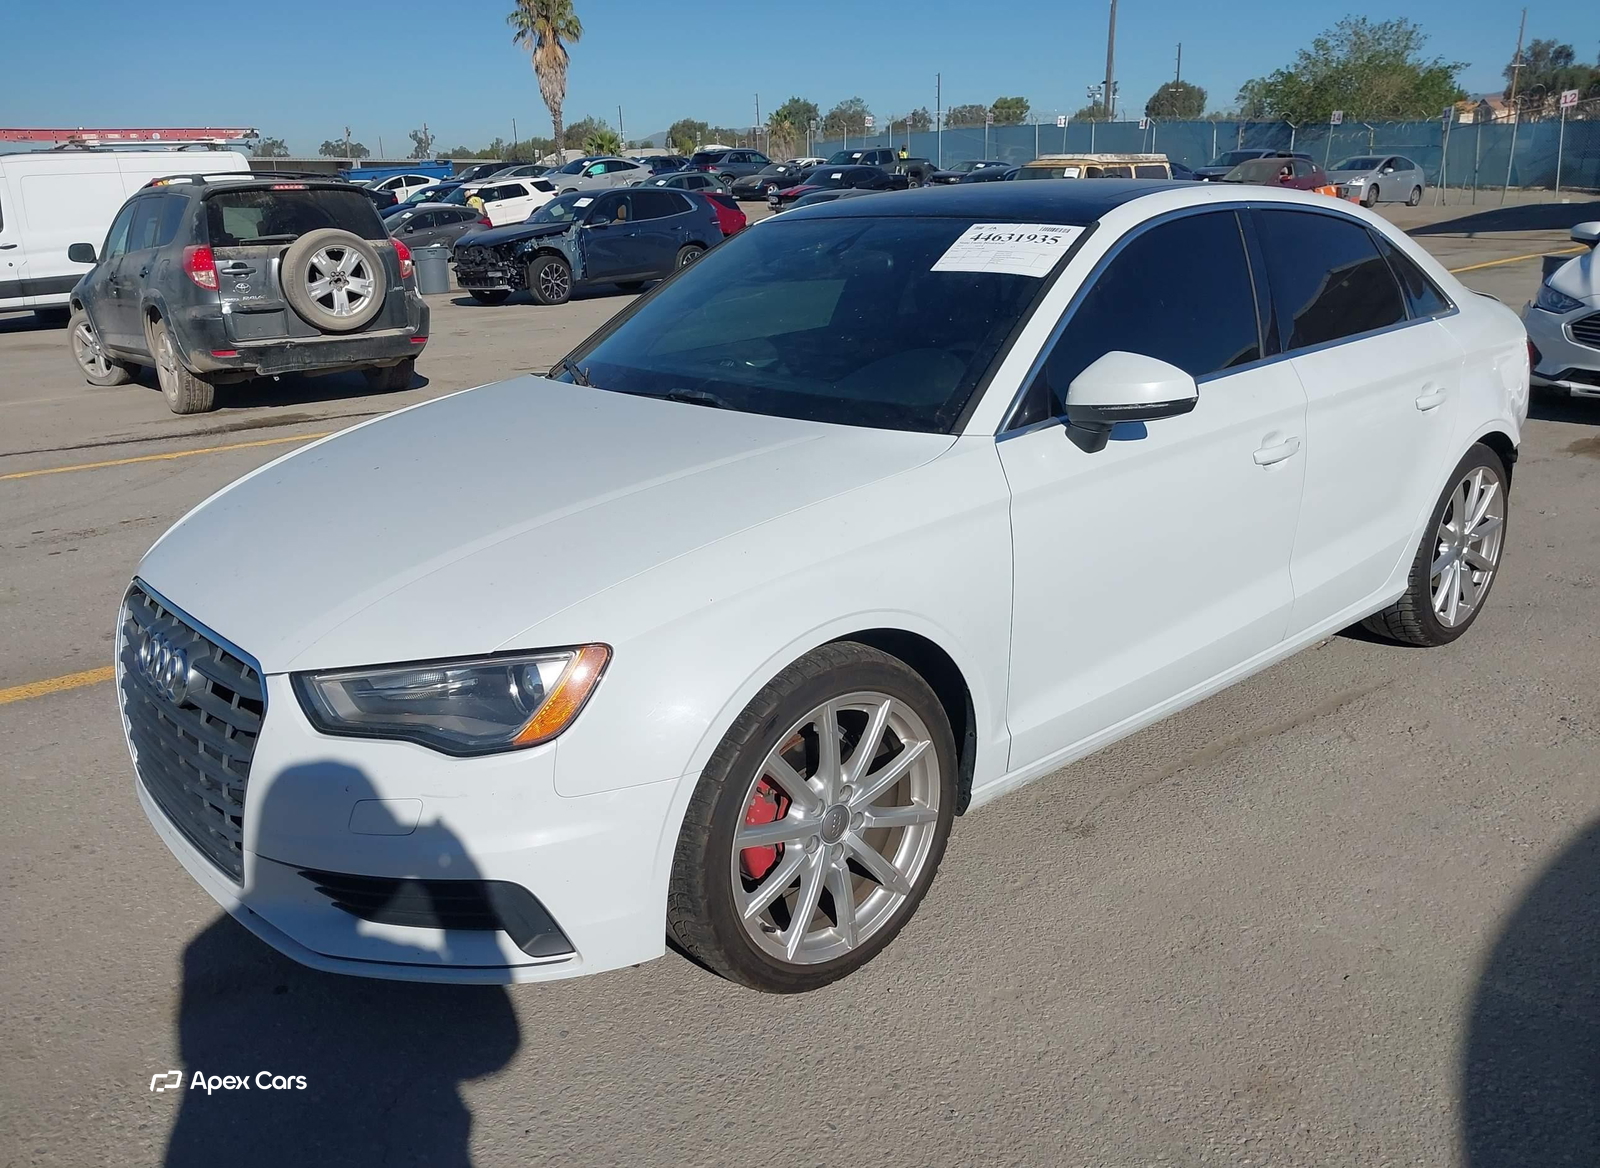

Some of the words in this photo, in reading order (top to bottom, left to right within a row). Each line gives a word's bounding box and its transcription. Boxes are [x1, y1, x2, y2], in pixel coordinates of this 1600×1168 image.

[1562, 92, 1578, 105] 12
[865, 117, 873, 125] 20
[1331, 113, 1341, 122] 14
[969, 232, 1062, 245] 44631935
